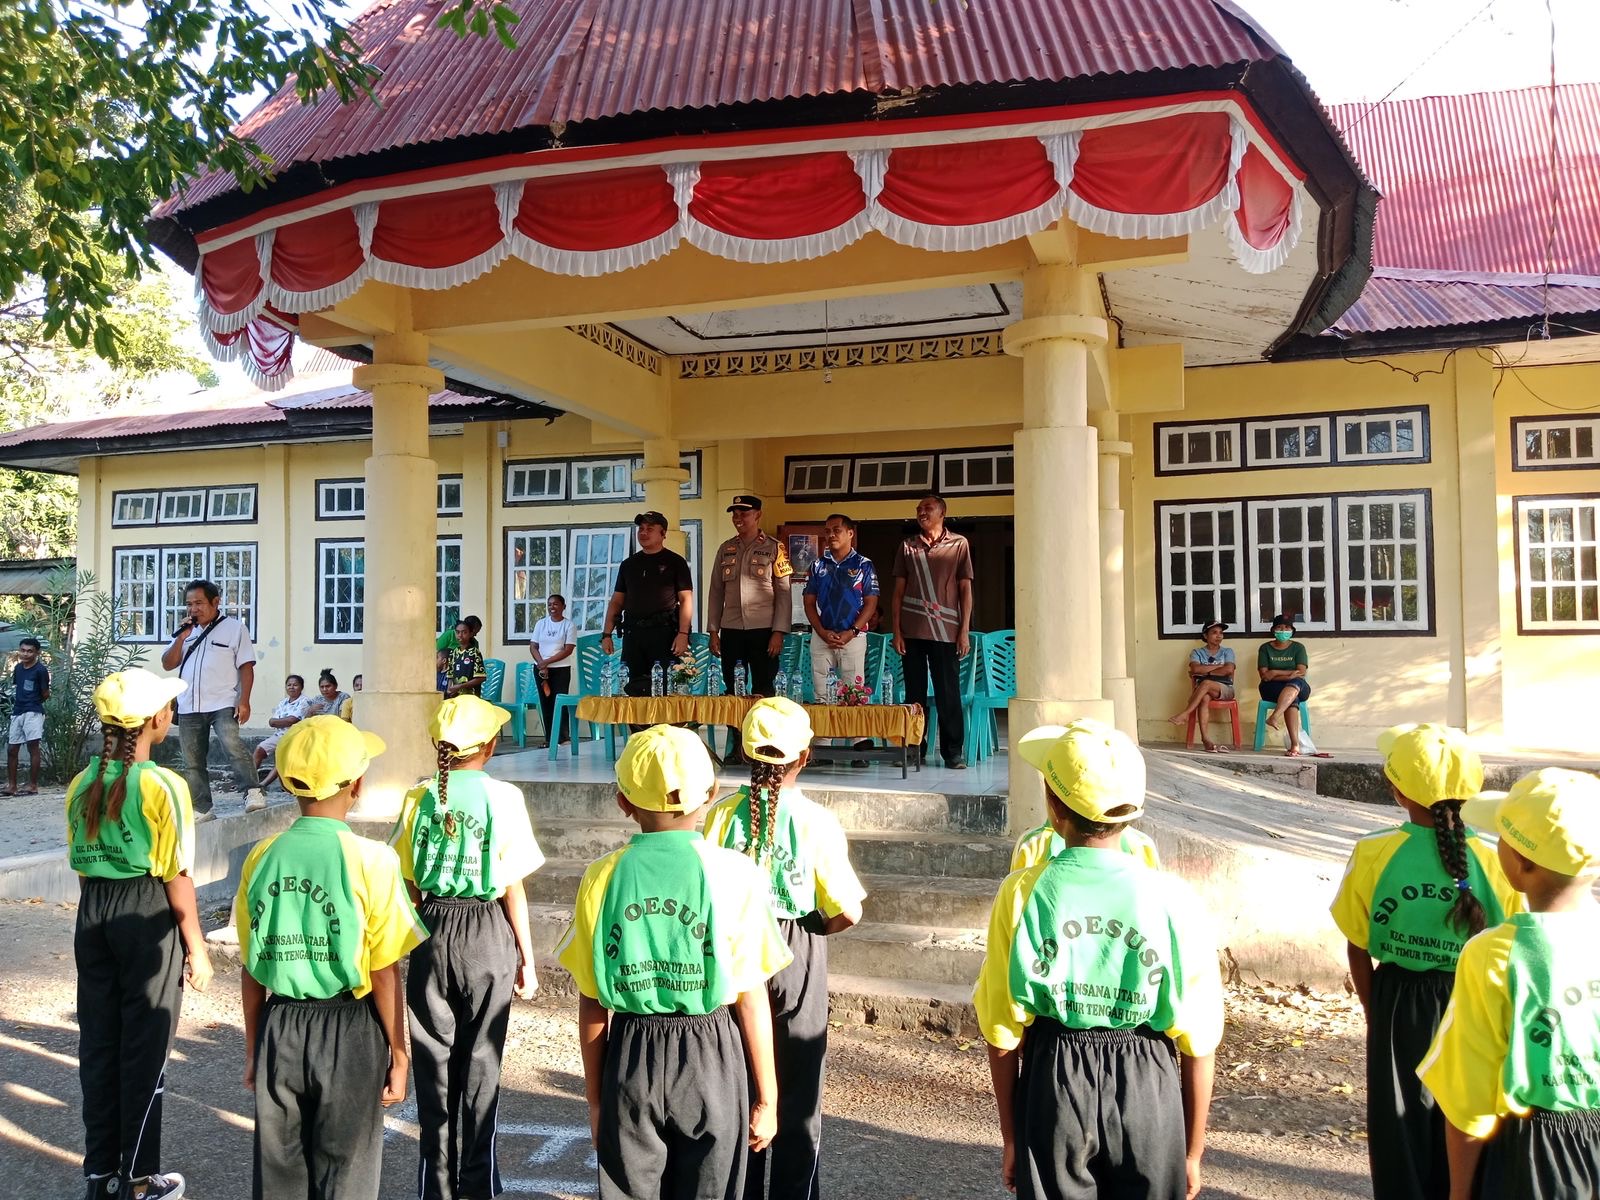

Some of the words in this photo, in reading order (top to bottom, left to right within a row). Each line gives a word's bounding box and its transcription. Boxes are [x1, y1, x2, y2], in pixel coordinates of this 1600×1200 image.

[430, 809, 491, 853] OSUSU
[267, 875, 341, 937] OESUSU
[1373, 896, 1399, 926] SD
[1401, 882, 1455, 903] OES
[605, 922, 624, 960] SD
[624, 896, 716, 958] OESUSU
[1408, 934, 1441, 950] INSANA
[1442, 939, 1463, 954] UTA
[619, 963, 641, 977] KEC.
[671, 962, 703, 975] UTARA
[1031, 938, 1059, 978] SD
[1062, 915, 1164, 987] OESUSU
[630, 978, 652, 993] TIMU
[652, 976, 681, 992] TENGAH
[682, 979, 710, 992] UTARA
[1070, 982, 1112, 999] INSANA
[1112, 987, 1148, 1005] UTARA
[1528, 1007, 1561, 1048] SD
